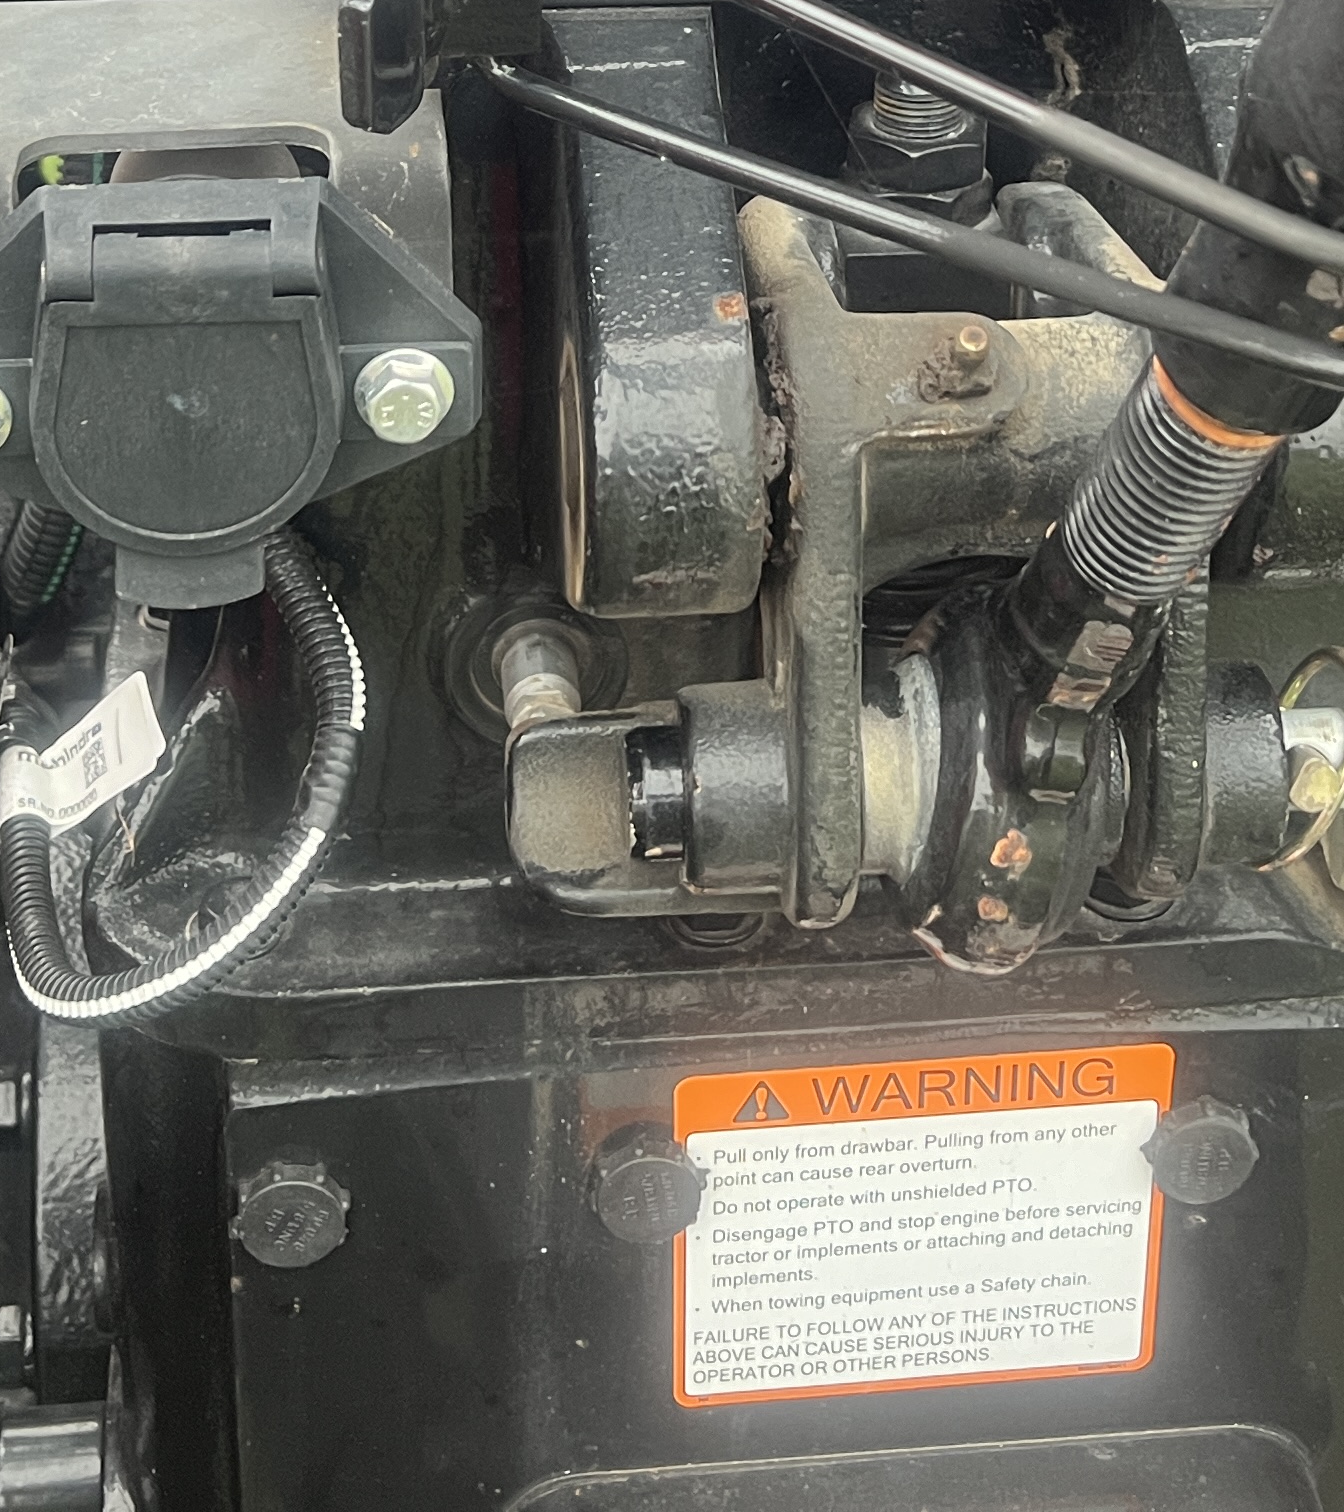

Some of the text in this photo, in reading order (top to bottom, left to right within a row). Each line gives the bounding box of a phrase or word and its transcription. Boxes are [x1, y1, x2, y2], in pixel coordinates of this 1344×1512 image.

[812, 1058, 1115, 1116] WARNING
[713, 1123, 1117, 1165] Pull only from drawbar. Pulling from any other
[713, 1158, 978, 1192] point can cause rear overturn.
[713, 1177, 1038, 1216] Do not operate with unshielded PTO.
[712, 1200, 1142, 1244] Disengage PTO and stop engine before servicing
[712, 1222, 1133, 1266] tractor or implements or attaching and detaching
[711, 1273, 1092, 1314] When towing equipment use a Safety chain.
[712, 1269, 819, 1290] implements.
[692, 1319, 1094, 1366] ABOVE CAN CAUSE SERIOUS INJURY TO THE
[693, 1297, 1137, 1346] FAILURE TO FOLLOW ANY OF THE INSTRUCTIONS
[693, 1363, 795, 1384] OPERATOR
[800, 1360, 828, 1376] OR
[833, 1355, 896, 1374] OTHER
